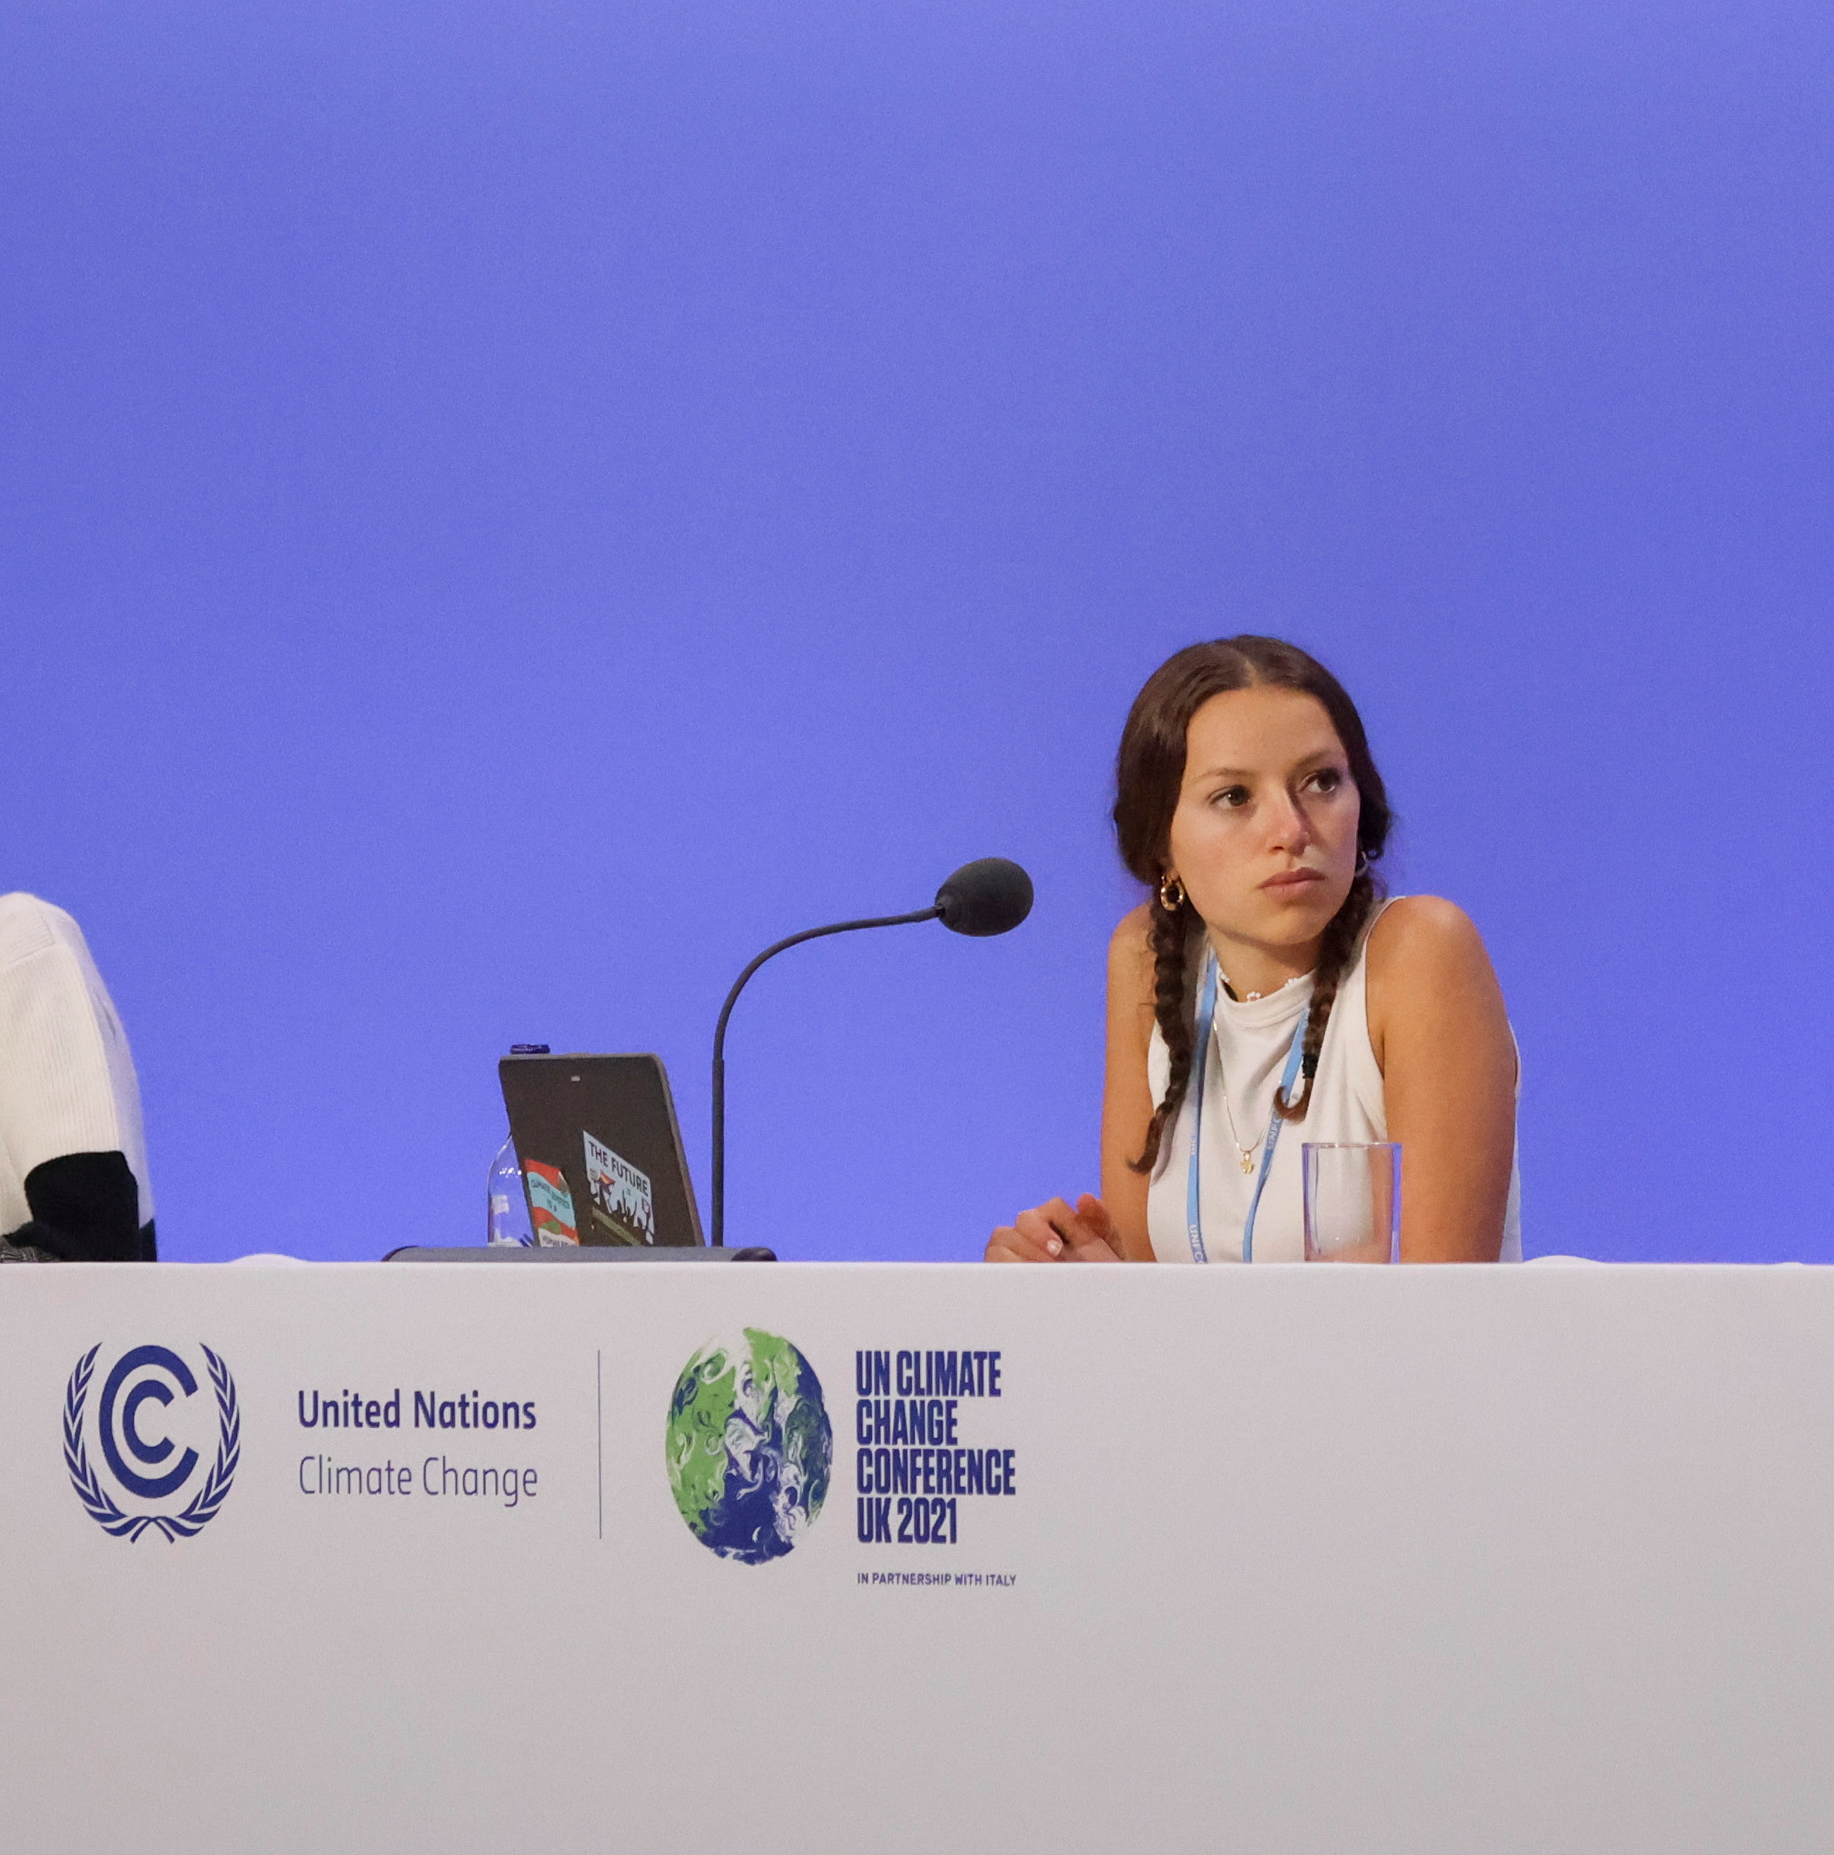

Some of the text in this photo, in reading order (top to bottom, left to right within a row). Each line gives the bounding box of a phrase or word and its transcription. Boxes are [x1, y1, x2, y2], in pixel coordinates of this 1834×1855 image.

[588, 1140, 649, 1197] THE FUTURE
[855, 1350, 1002, 1397] UN CLIMATE
[298, 1388, 537, 1430] United Nations
[856, 1398, 958, 1447] CHANGE
[299, 1453, 538, 1508] Climate Change
[856, 1447, 1016, 1496] CONFERENCE
[856, 1496, 957, 1544] UK 2021
[857, 1572, 1016, 1587] IN PARTNERSHIP WITH ITALY
